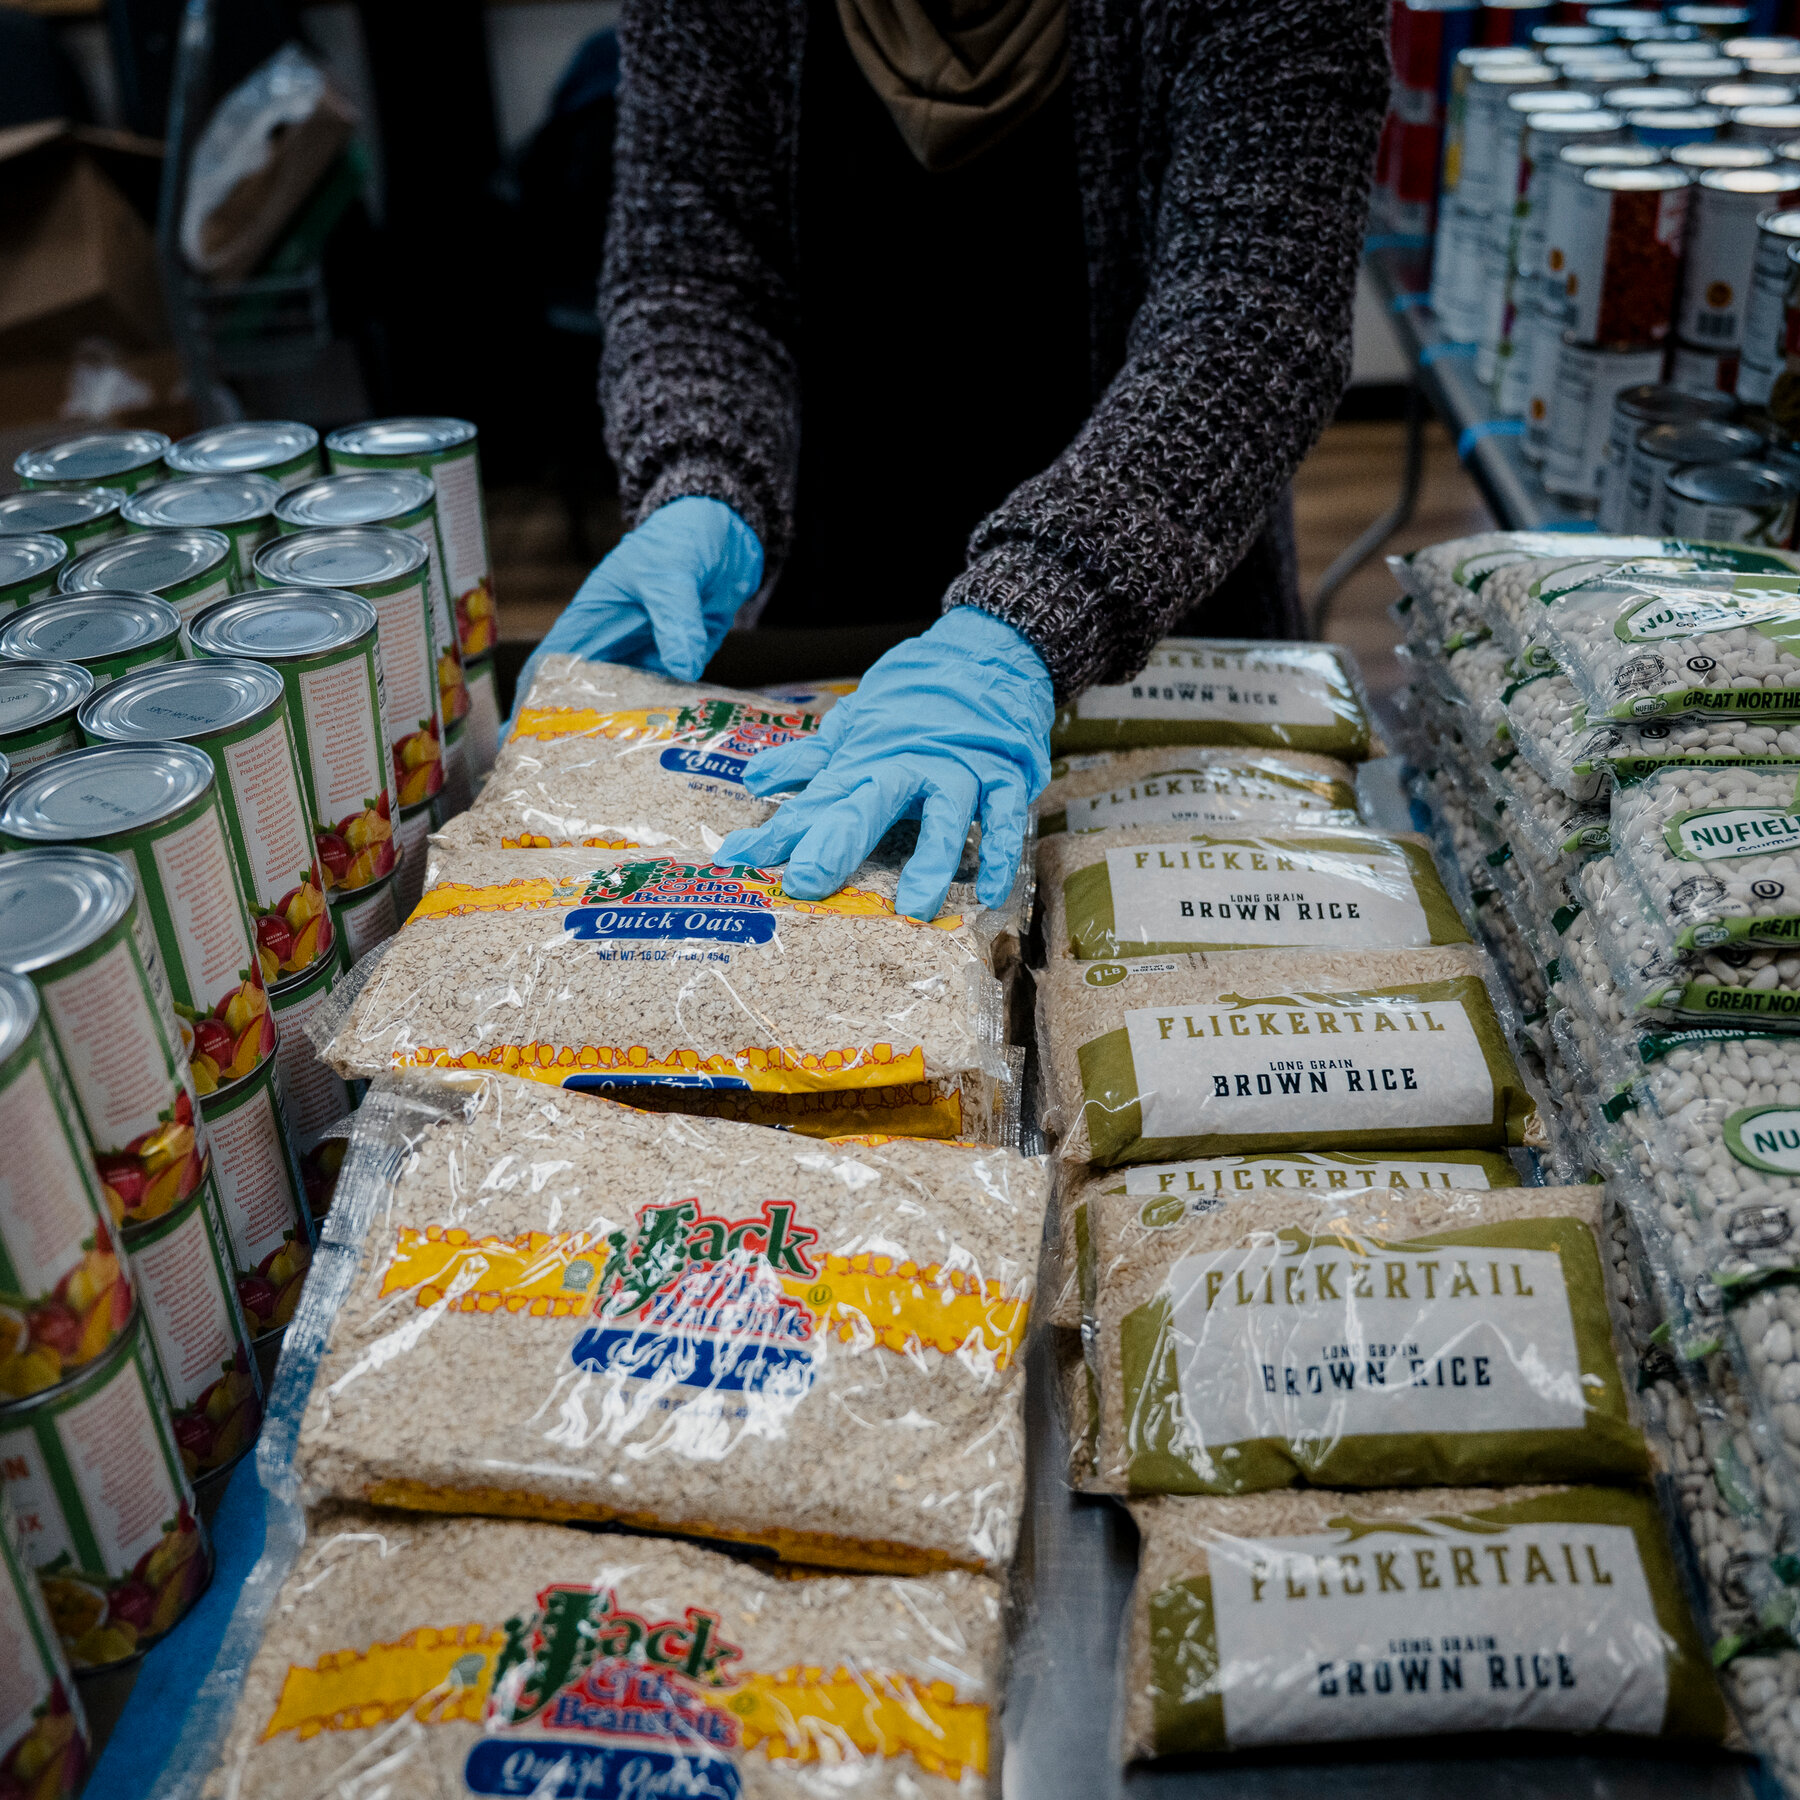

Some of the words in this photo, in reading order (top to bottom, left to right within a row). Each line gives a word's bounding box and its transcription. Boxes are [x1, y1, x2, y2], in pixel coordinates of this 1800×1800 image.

[1132, 686, 1214, 701] BROWN
[1228, 691, 1278, 705] RICE
[1683, 692, 1733, 708] GREAT
[584, 859, 771, 903] Jack
[658, 880, 695, 893] &
[695, 881, 739, 893] the
[629, 891, 769, 908] Beanstalk
[1230, 894, 1260, 903] LONG
[1266, 893, 1305, 902] GRAIN
[1180, 901, 1280, 921] BROWN
[1299, 902, 1361, 920] RICE
[595, 911, 675, 934] Quick
[684, 912, 746, 932] Oats
[599, 950, 616, 960] NET
[620, 950, 637, 961] WT.
[641, 950, 650, 960] 16
[706, 952, 730, 964] 454g
[1093, 970, 1103, 982] 1
[1104, 967, 1121, 977] LB
[1706, 990, 1765, 1009] GREAT
[1158, 1010, 1444, 1040] FLICKERTAIL
[1269, 1060, 1304, 1071] LONG
[1310, 1059, 1353, 1071] GRAIN
[1213, 1071, 1328, 1097] BROWN
[1348, 1068, 1418, 1093] RICE
[1158, 1169, 1456, 1195] FLICKERTAIL
[599, 1202, 813, 1316] Jack
[1205, 1259, 1534, 1311] FLICKERTAIL
[1321, 1345, 1359, 1361] LONG
[1368, 1343, 1419, 1358] GRAIN
[1262, 1361, 1389, 1397] BROWN
[1411, 1356, 1491, 1388] RICE
[1250, 1542, 1613, 1601] FLICKERTAIL
[493, 1590, 735, 1726] Jack
[1317, 1656, 1464, 1697] BROWN
[1489, 1652, 1576, 1692] RICE
